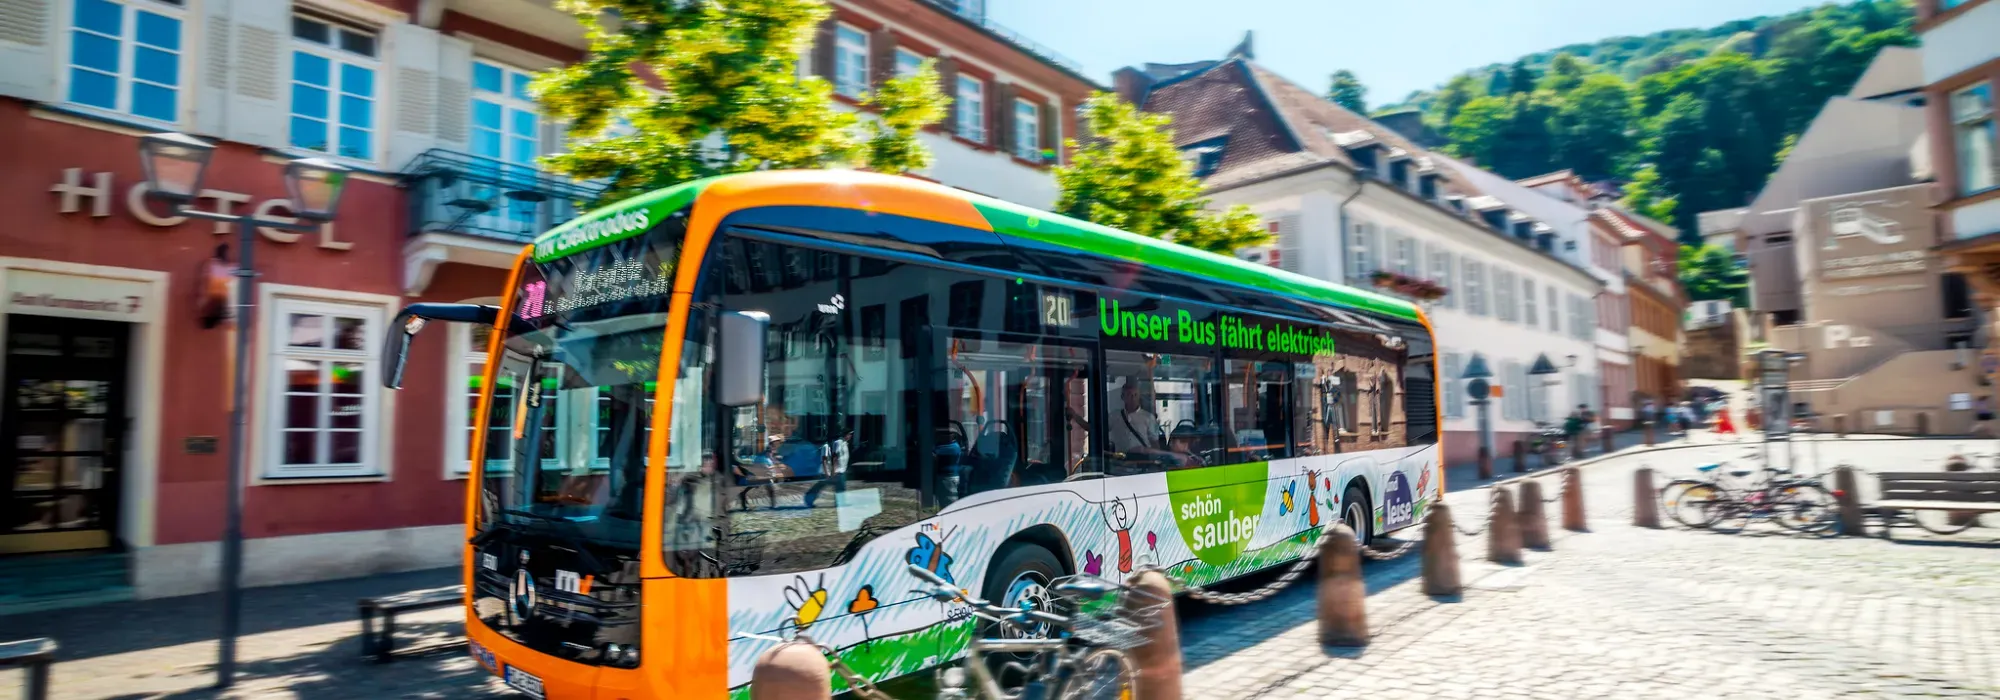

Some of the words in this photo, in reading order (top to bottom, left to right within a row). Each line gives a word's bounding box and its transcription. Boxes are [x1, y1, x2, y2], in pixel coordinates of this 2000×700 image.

[49, 167, 355, 250] HOTEL
[1047, 295, 1067, 326] 20
[1100, 297, 1171, 341] Unser
[1178, 309, 1216, 346] Bus
[1220, 315, 1263, 351] fährt
[1267, 323, 1335, 357] elektrisch
[1181, 493, 1222, 520] schön
[1387, 497, 1412, 525] leise
[1193, 509, 1260, 551] sauber
